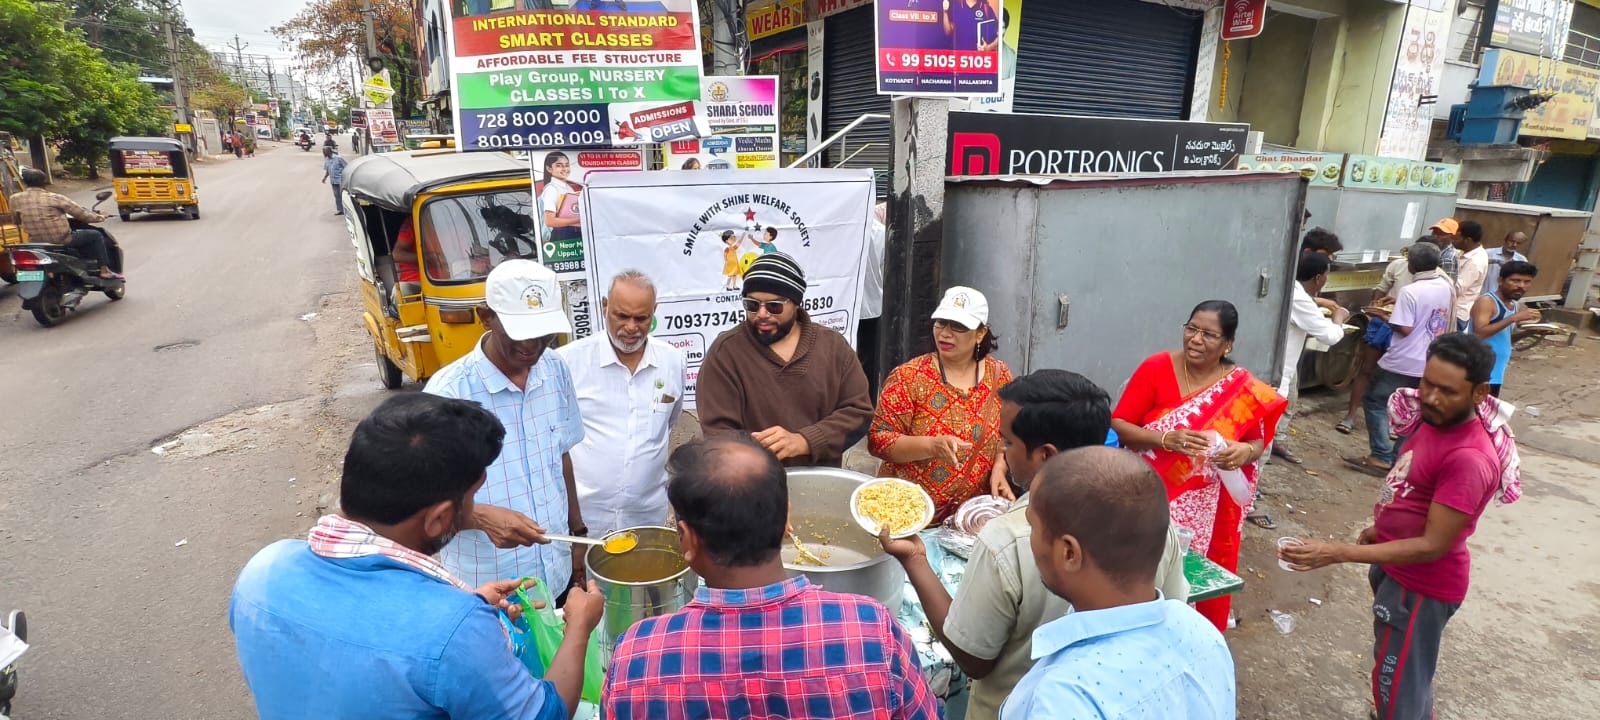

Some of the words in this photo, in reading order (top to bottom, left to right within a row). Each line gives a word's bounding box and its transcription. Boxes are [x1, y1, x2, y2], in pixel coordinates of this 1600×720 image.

[473, 14, 595, 31] INTERNATIONAL
[599, 15, 678, 28] STANDARD
[752, 7, 791, 35] WEAR
[1233, 9, 1255, 19] Airtel
[1233, 17, 1253, 26] Wi-Fi
[499, 32, 565, 49] SMART
[571, 31, 653, 47] CLASSES
[476, 54, 564, 69] AFFORDABLE
[572, 53, 597, 64] FEE
[604, 53, 682, 64] STRUCTURE
[901, 53, 920, 67] 99
[924, 54, 956, 67] 5105
[960, 56, 992, 69] 5105
[489, 73, 522, 88] Play
[528, 71, 584, 86] Group,
[589, 69, 665, 82] NURSERY
[510, 87, 592, 103] CLASSES
[599, 88, 604, 99] I
[611, 87, 628, 98] To
[634, 86, 645, 98] X
[476, 112, 507, 129] 728
[512, 111, 549, 127] 800
[553, 109, 600, 125] 2000
[634, 106, 688, 124] ADMISSIONS
[706, 104, 737, 118] SHARA
[739, 103, 774, 116] SCHOOL
[478, 132, 522, 147] 8019
[528, 131, 564, 147] 008
[569, 130, 604, 145] 009
[652, 121, 691, 139] OPEN
[1009, 149, 1164, 174] PORTRONICS
[683, 225, 702, 256] SMILE
[699, 203, 721, 224] WITH
[722, 193, 750, 208] SHINE
[752, 193, 791, 215] WELFARE
[789, 211, 811, 248] SOCIETY
[557, 249, 579, 257] Uppal,
[554, 261, 579, 271] 93988
[664, 309, 746, 329] 709373745
